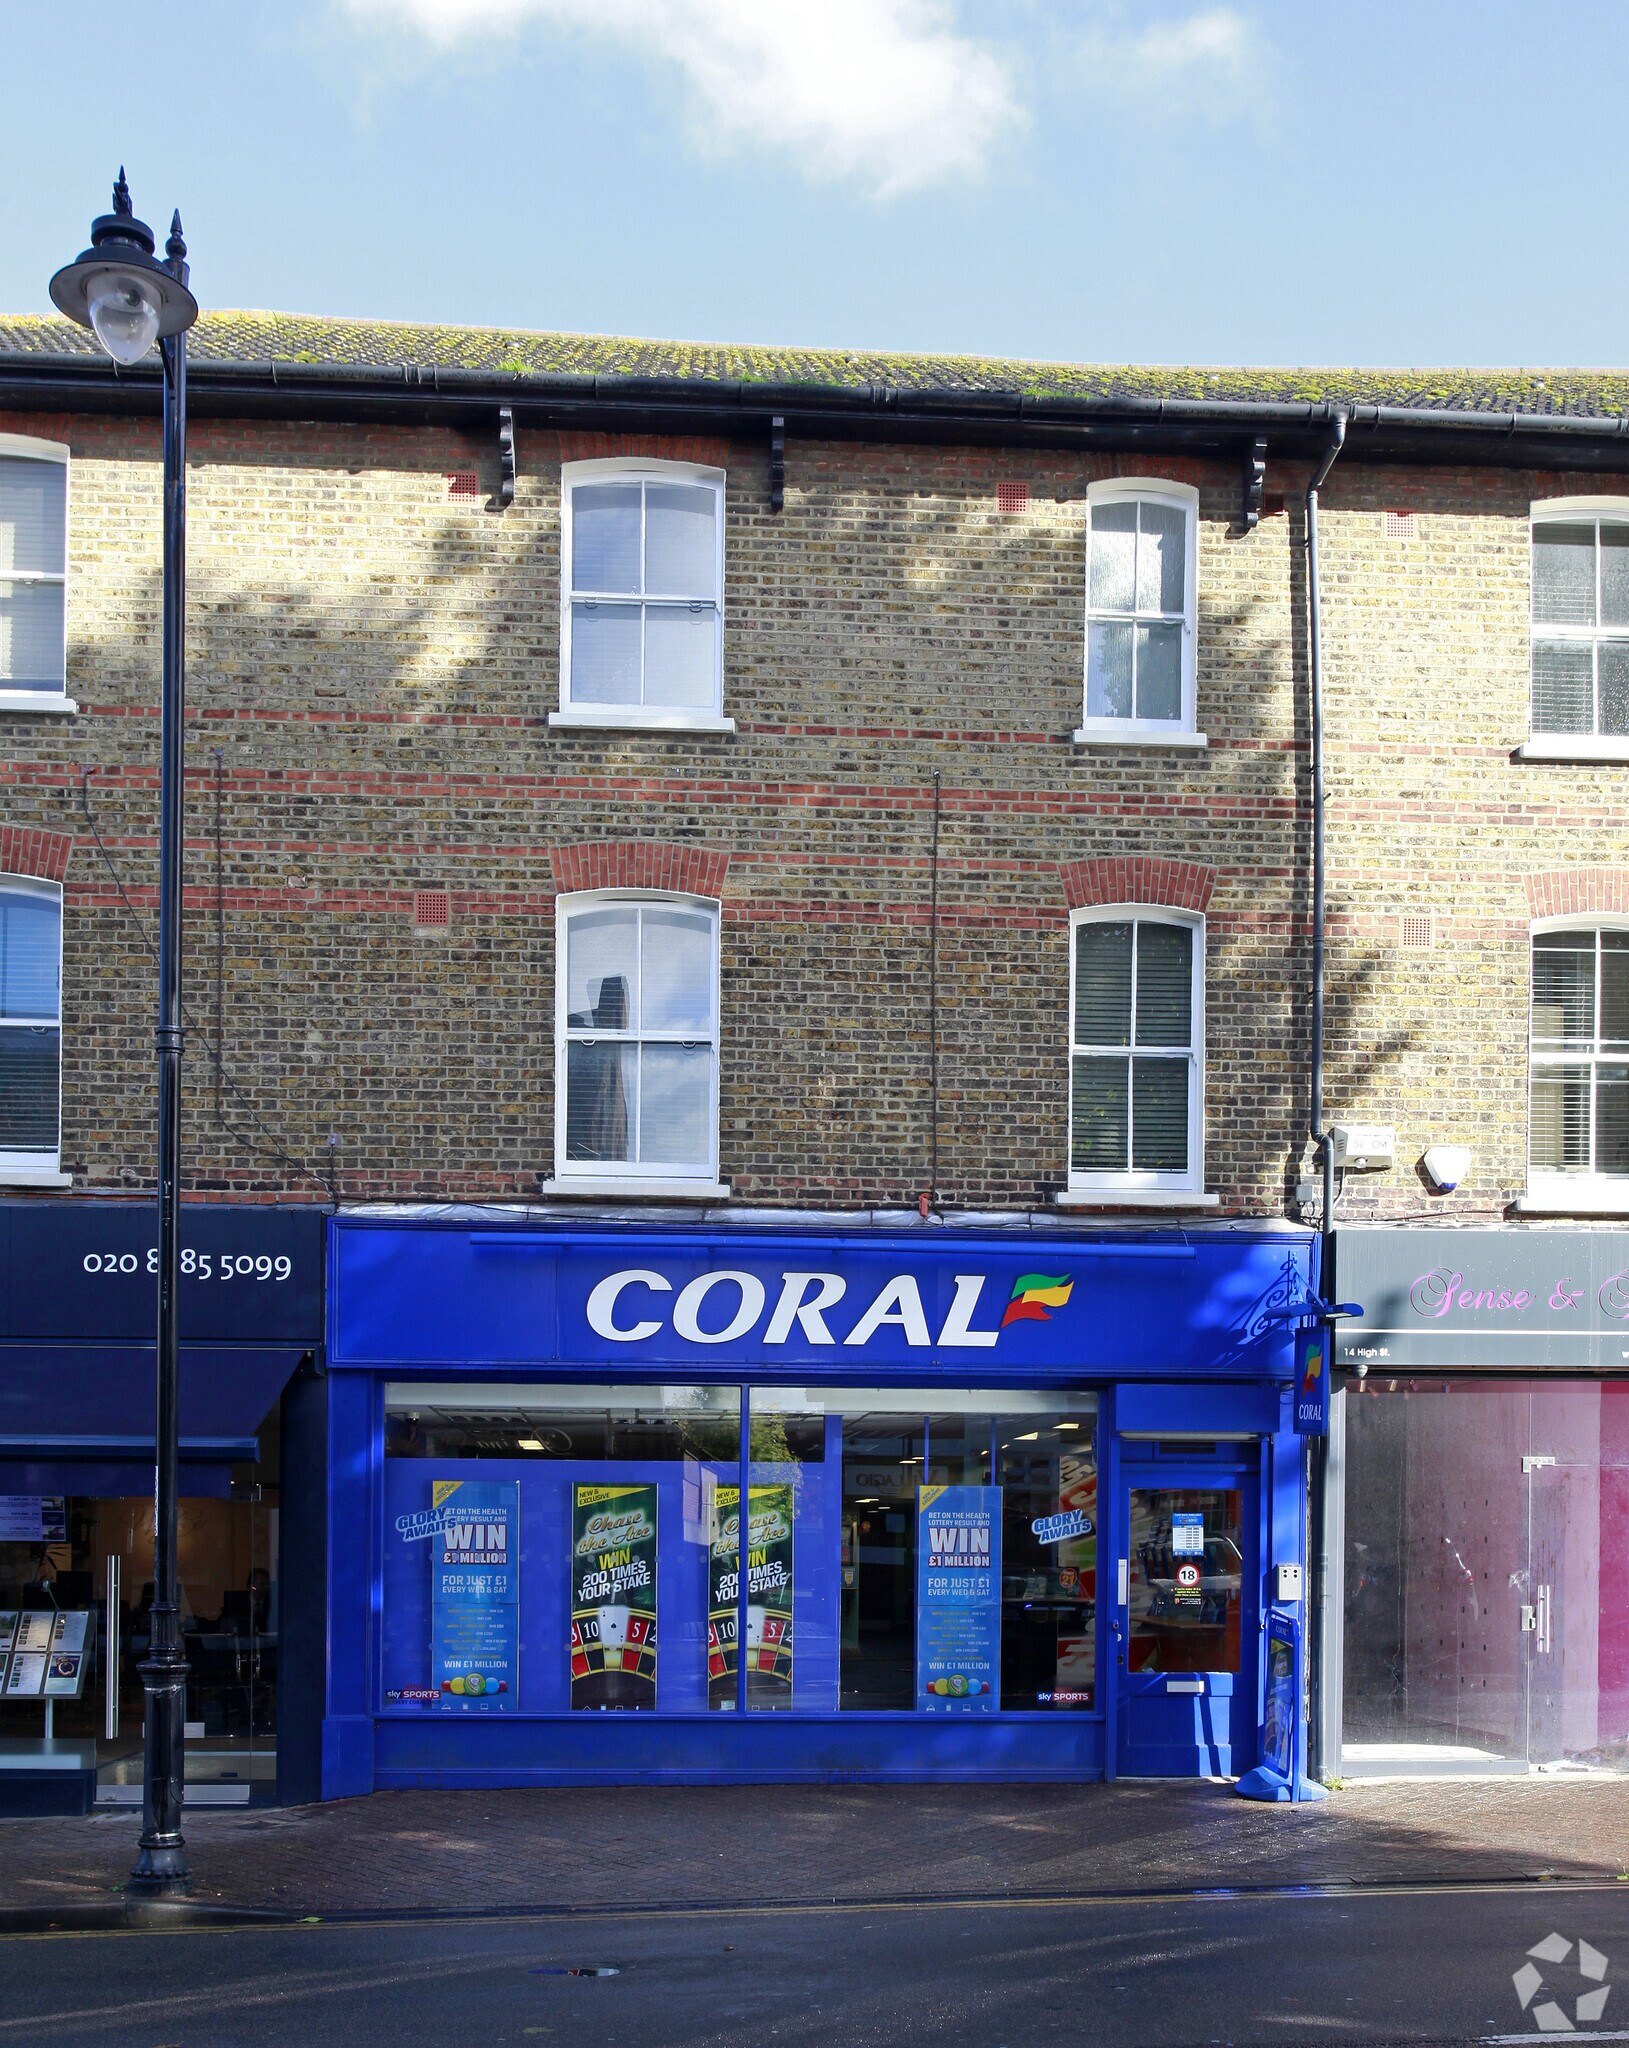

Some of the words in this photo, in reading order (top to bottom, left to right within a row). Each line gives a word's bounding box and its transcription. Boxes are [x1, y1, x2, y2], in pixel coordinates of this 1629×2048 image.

[83, 1253, 138, 1273] 020
[146, 1248, 212, 1280] 885
[220, 1255, 292, 1281] 5099
[1409, 1267, 1537, 1318] Sense
[1548, 1277, 1586, 1310] &
[586, 1269, 1000, 1347] CORAL
[1344, 1347, 1355, 1356] 14
[1357, 1347, 1377, 1358] High
[1380, 1347, 1390, 1356] St.
[1298, 1404, 1322, 1421] CORAL
[579, 1490, 594, 1498] NEW
[580, 1492, 610, 1505] EXCLUSIVE
[716, 1491, 731, 1499] NEW
[716, 1495, 740, 1506] EXCLUSI
[397, 1507, 447, 1530] GLORY
[456, 1508, 467, 1516] ON
[468, 1508, 480, 1516] THE
[482, 1508, 507, 1516] HEALTH
[1034, 1509, 1082, 1532] GLORY
[404, 1518, 457, 1541] AWAITS
[588, 1512, 642, 1534] Chase
[725, 1513, 778, 1535] Case
[1040, 1520, 1091, 1542] AWAITS
[445, 1524, 506, 1550] WIN
[578, 1536, 608, 1554] the
[612, 1526, 651, 1544] Ace
[716, 1536, 740, 1554] th
[749, 1526, 786, 1546] Ace
[929, 1528, 990, 1553] WIN
[598, 1546, 631, 1570] WIN
[928, 1556, 942, 1567] £1
[944, 1556, 990, 1567] MILLION
[582, 1570, 608, 1588] 200
[610, 1560, 647, 1580] TIMES
[747, 1560, 783, 1580] TIMES
[1180, 1570, 1196, 1581] 18
[442, 1576, 464, 1586] FOR
[466, 1576, 492, 1586] JUST
[495, 1576, 507, 1586] £1
[442, 1586, 466, 1594] EVERY
[468, 1586, 484, 1594] WED
[493, 1586, 507, 1594] SAT
[578, 1583, 611, 1602] YOUR
[613, 1572, 651, 1593] STAKE
[715, 1585, 740, 1602] YOU
[750, 1572, 787, 1594] STAKE
[928, 1578, 948, 1588] FOR
[950, 1578, 976, 1588] JUST
[978, 1578, 990, 1588] £1
[584, 1621, 599, 1639] 10
[632, 1622, 641, 1638] 5
[720, 1621, 736, 1639] 10
[768, 1622, 776, 1638] 5
[444, 1660, 461, 1668] WIN
[463, 1660, 473, 1668] £1
[474, 1660, 508, 1668] MILLION
[928, 1662, 944, 1670] WIN
[946, 1662, 956, 1670] £1
[958, 1662, 990, 1670] MILLION
[387, 1690, 400, 1699] sky
[404, 1690, 440, 1698] SPORTS
[1038, 1692, 1051, 1702] sky
[1054, 1692, 1089, 1700] SPORTS
